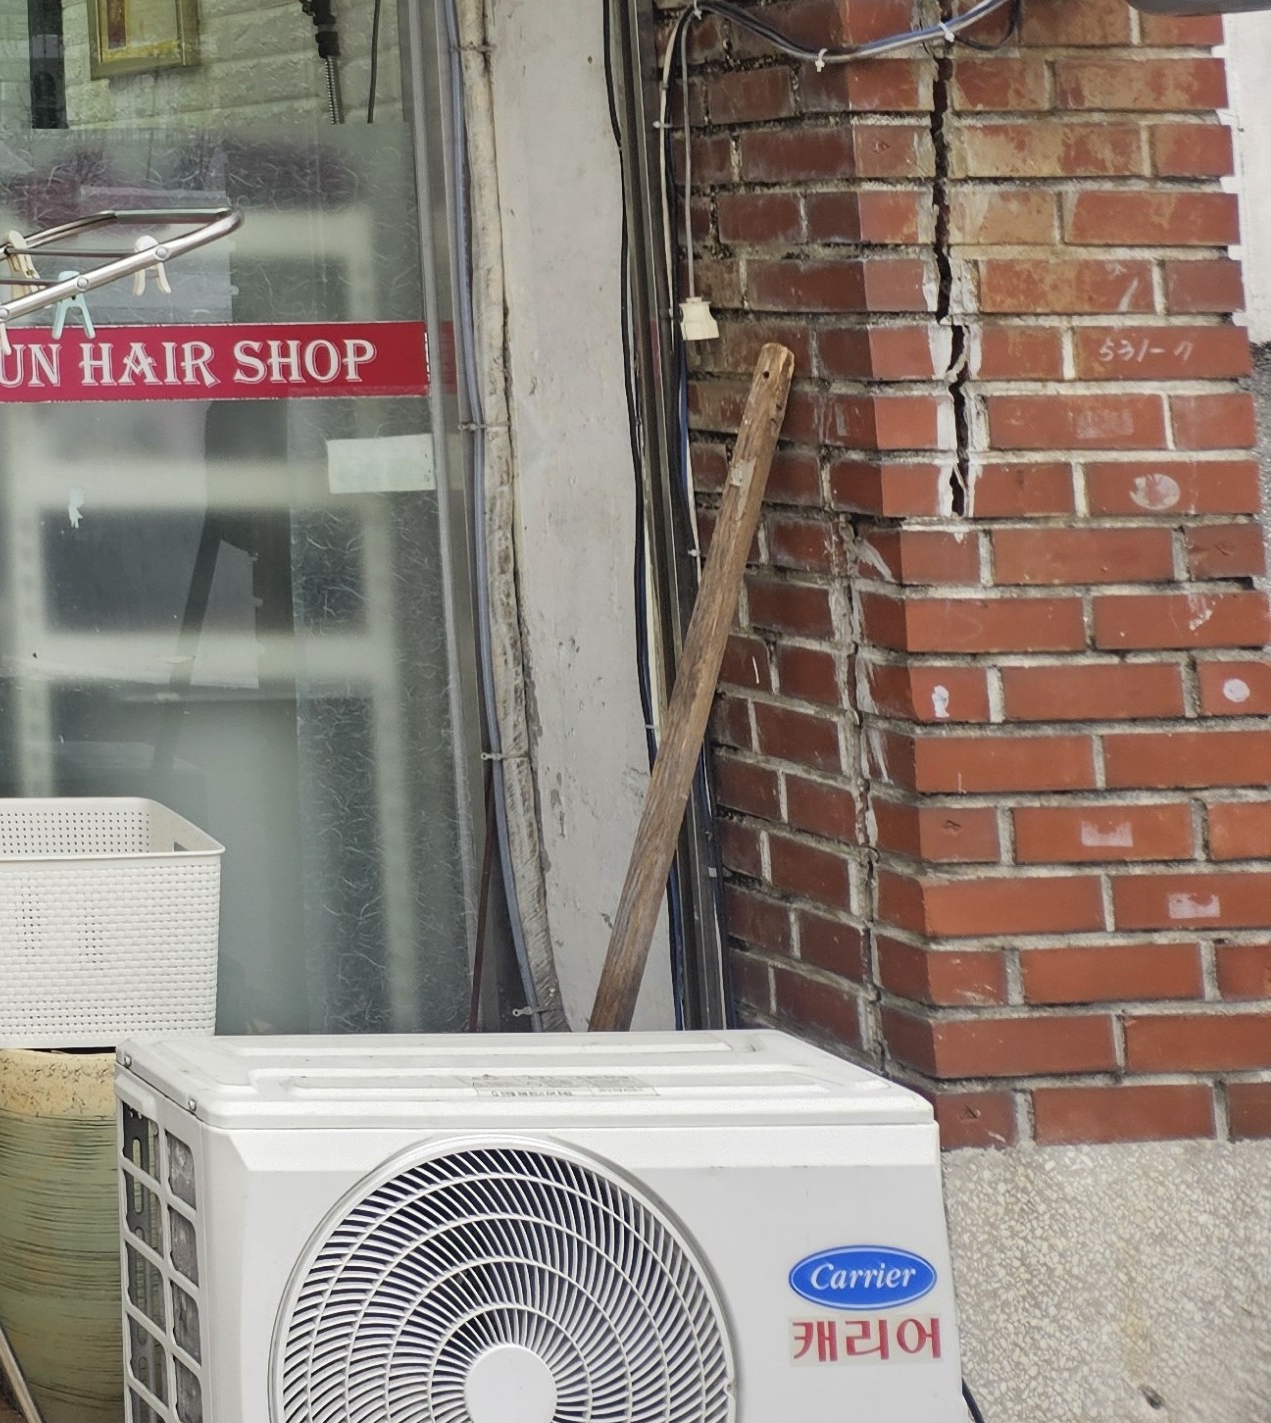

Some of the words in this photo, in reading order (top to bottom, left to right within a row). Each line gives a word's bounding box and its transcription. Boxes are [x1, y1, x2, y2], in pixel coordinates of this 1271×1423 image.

[79, 341, 221, 388] HAIR
[232, 338, 378, 385] SHOP
[811, 1262, 917, 1291] Carrier
[792, 1317, 942, 1363] 캐리어
